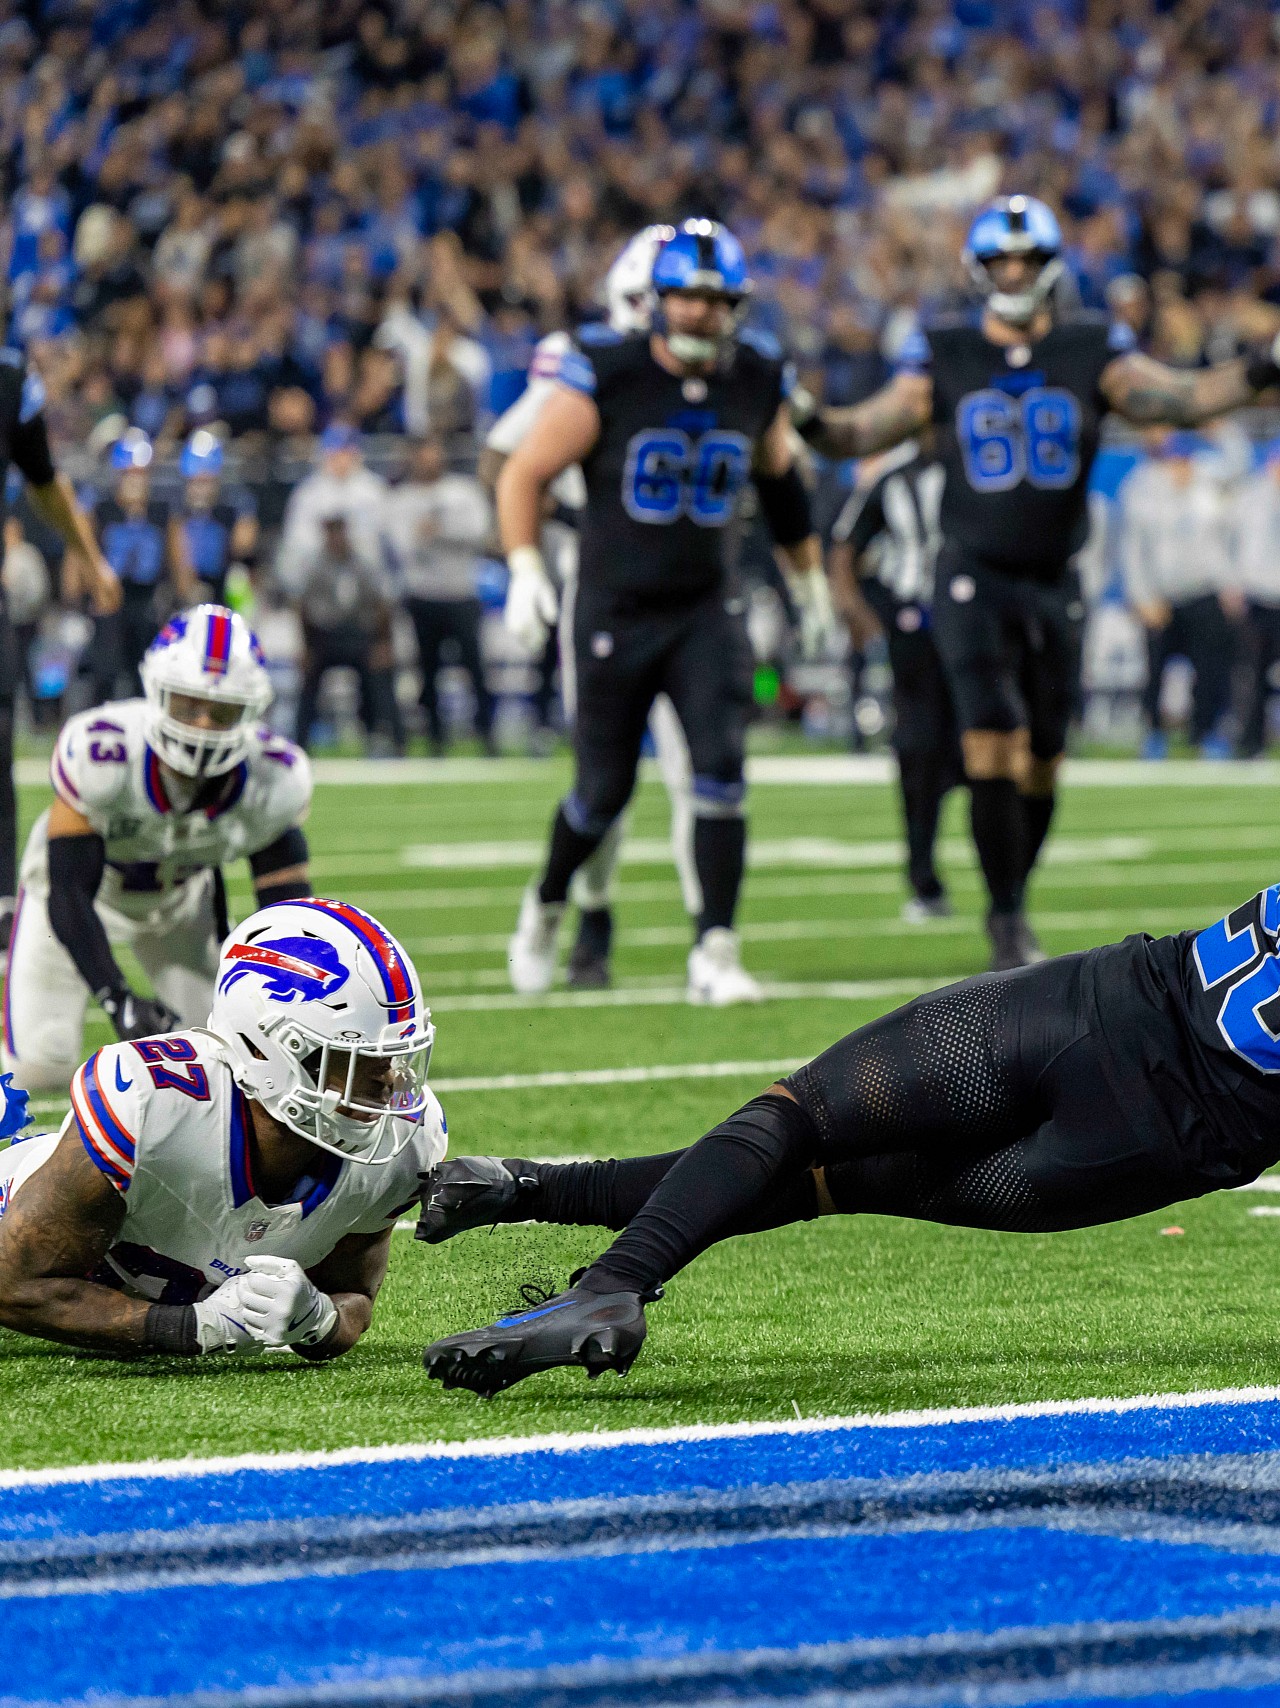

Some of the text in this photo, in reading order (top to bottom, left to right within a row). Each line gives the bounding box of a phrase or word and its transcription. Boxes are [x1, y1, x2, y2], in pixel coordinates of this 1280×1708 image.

[956, 386, 1083, 493] 68
[128, 1037, 212, 1101] 27
[333, 1036, 367, 1044] OAKLEY
